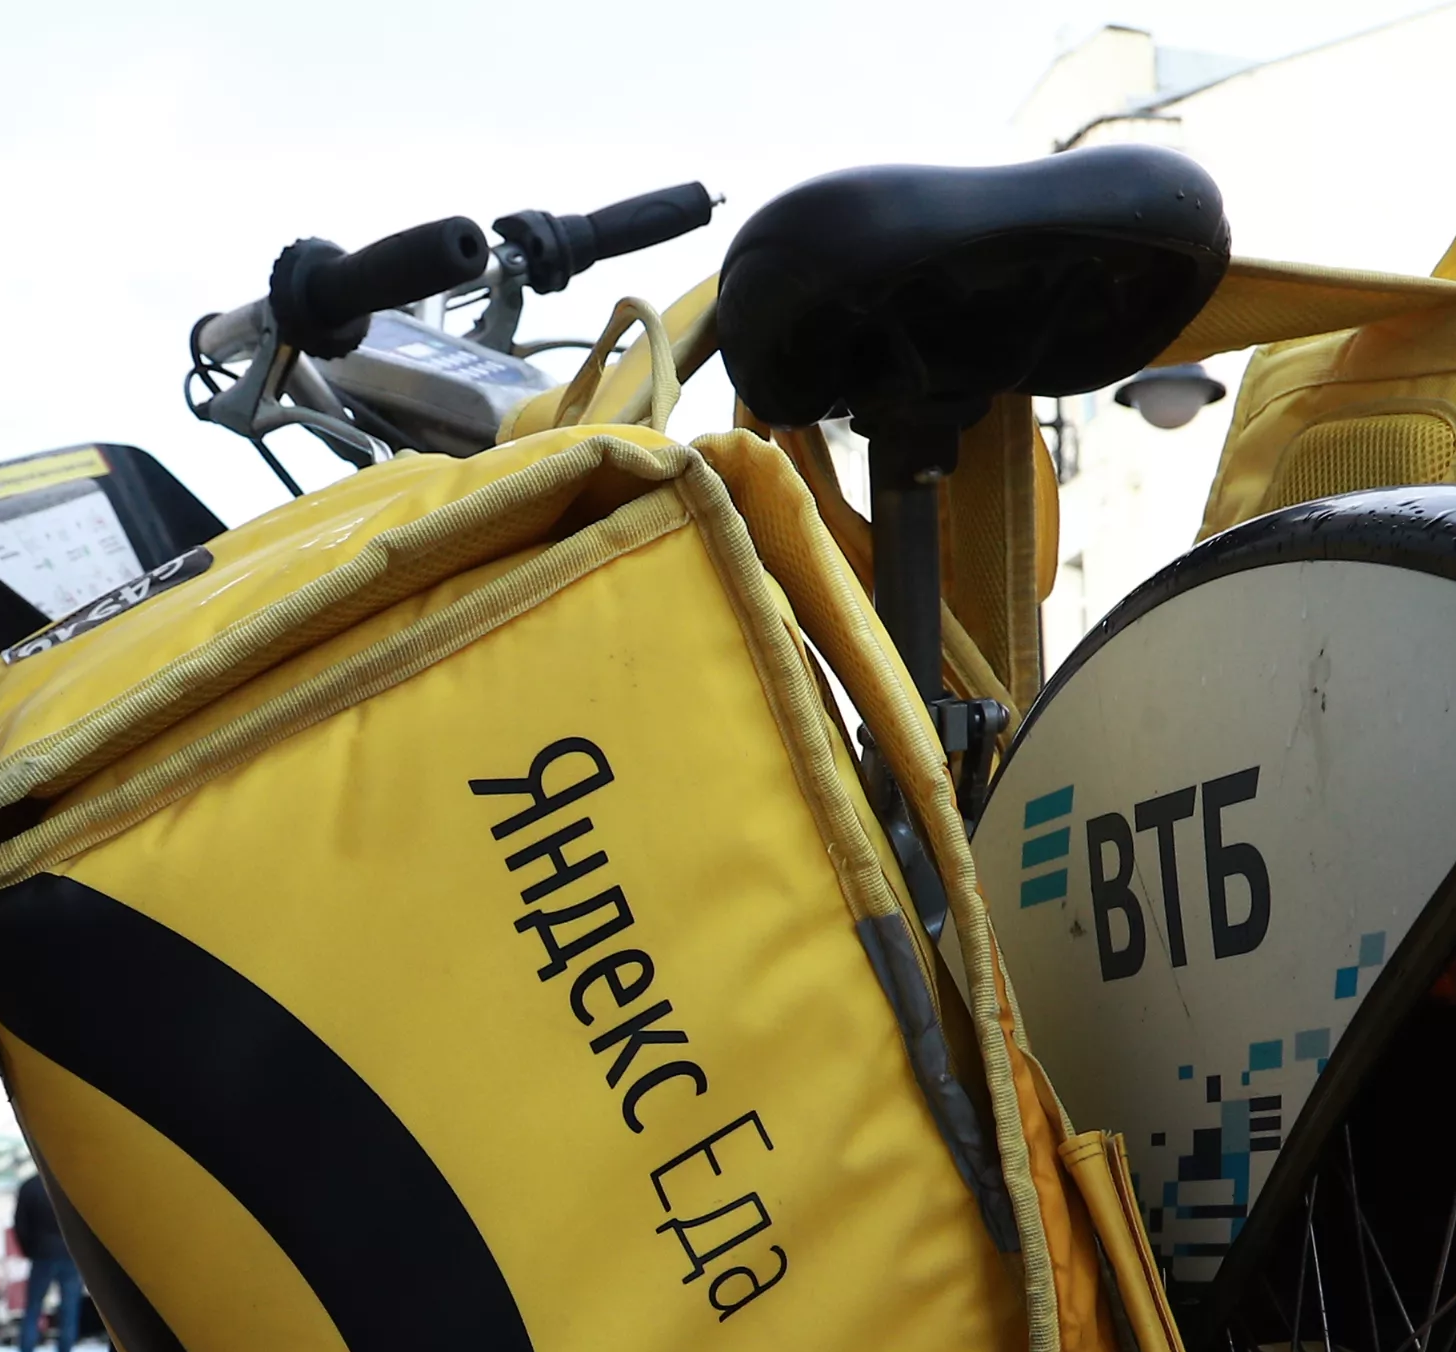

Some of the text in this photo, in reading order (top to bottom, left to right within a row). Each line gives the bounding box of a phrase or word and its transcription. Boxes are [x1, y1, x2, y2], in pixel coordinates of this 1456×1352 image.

[467, 737, 788, 1322] Яндекс Еда
[1085, 765, 1271, 982] ВТБ
